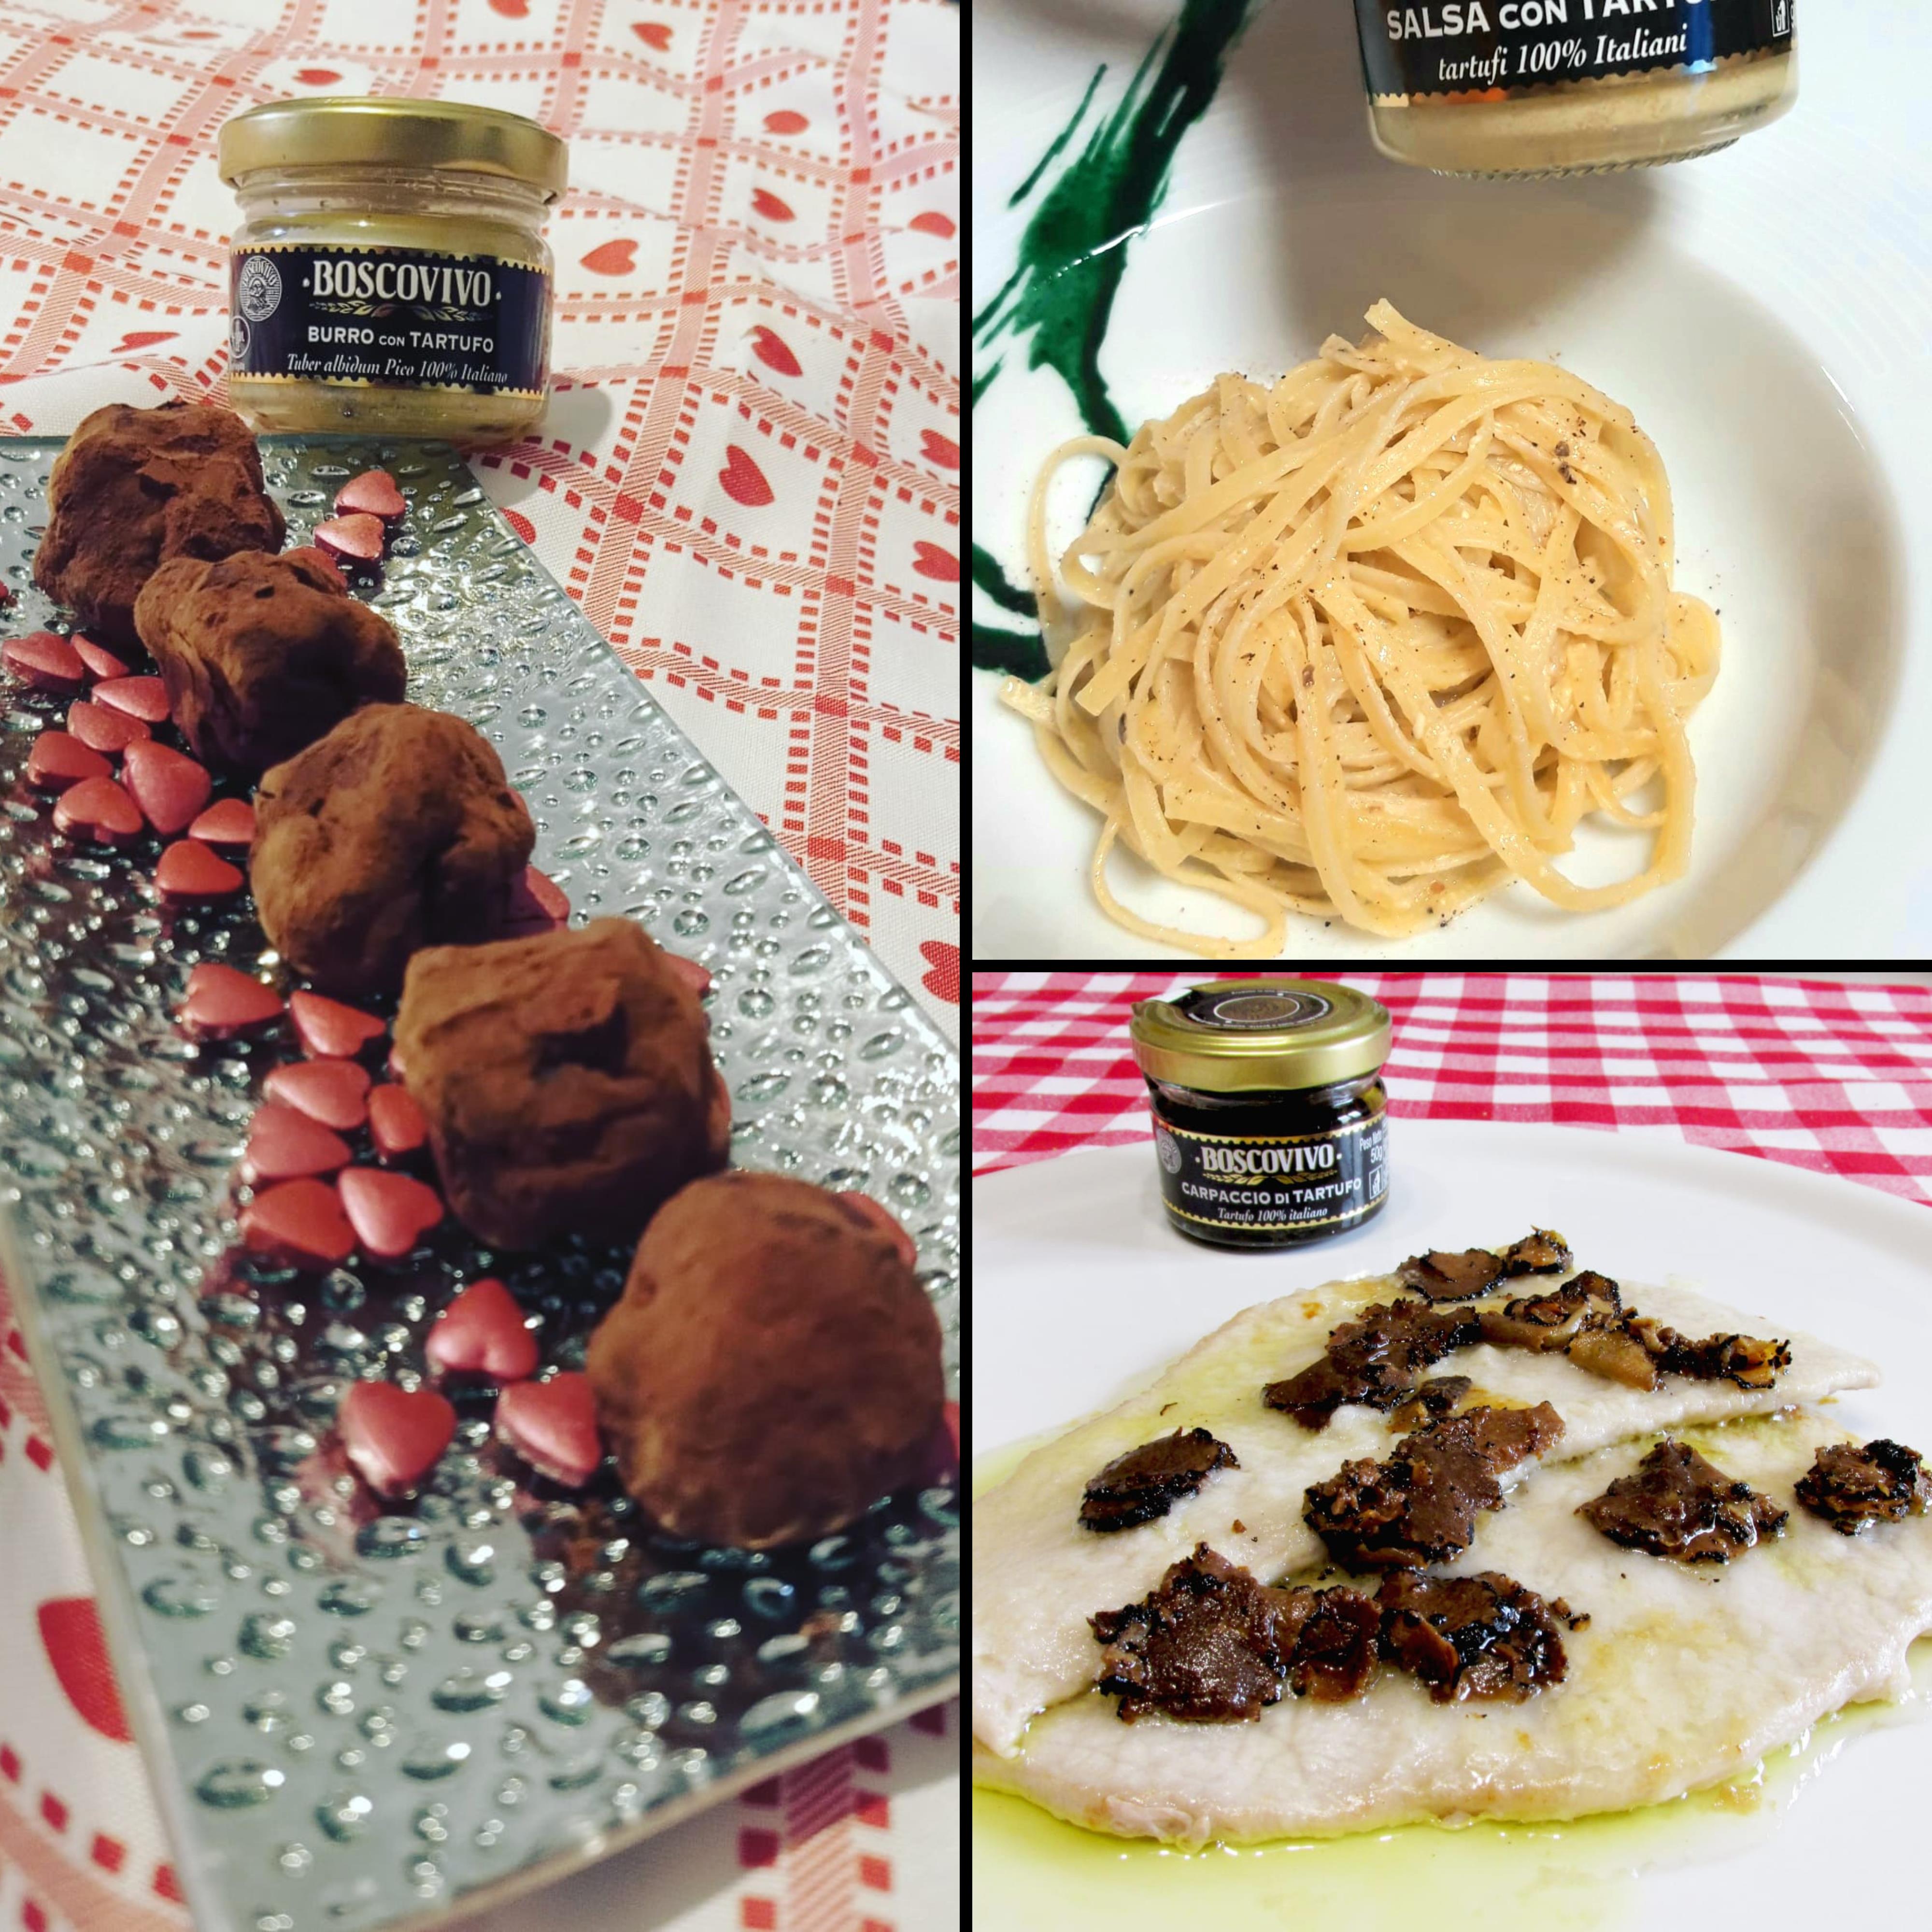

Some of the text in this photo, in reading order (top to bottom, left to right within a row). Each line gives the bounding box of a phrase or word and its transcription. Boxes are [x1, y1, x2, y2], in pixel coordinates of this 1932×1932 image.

[1387, 1, 1491, 40] SALSA
[1499, 0, 1568, 29] CON
[1439, 23, 1688, 85] tartufi 100% Italiani
[313, 260, 491, 307] BOSCOVIVO
[308, 326, 374, 344] BURRO
[410, 331, 494, 353] TARTUFO
[287, 353, 508, 383] Tuber albidum Pico 100% Italiano
[1200, 1143, 1335, 1174] BOSCOVIVO
[1360, 1137, 1372, 1151] Peso
[1181, 1178, 1362, 1205] CARPACCIO DI TARTUFO
[1218, 1207, 1328, 1222] Tartufo 100% italiano
